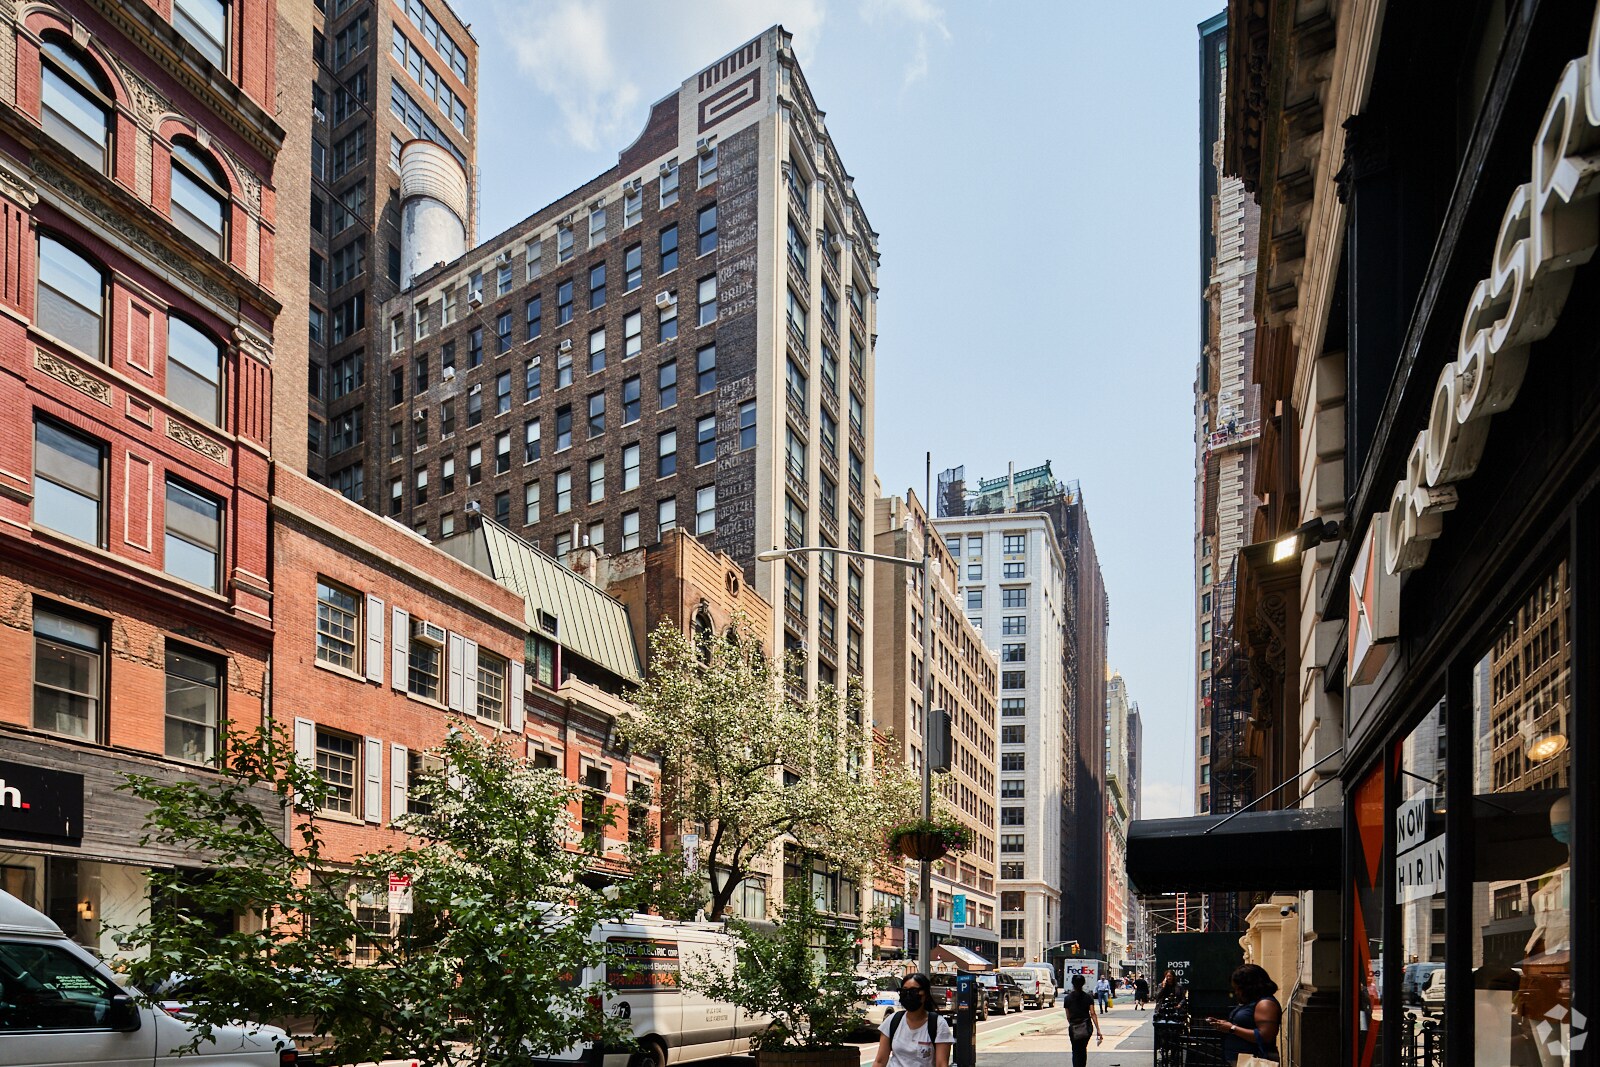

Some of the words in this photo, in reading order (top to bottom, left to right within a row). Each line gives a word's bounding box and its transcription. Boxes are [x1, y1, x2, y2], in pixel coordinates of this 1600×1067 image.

[721, 278, 753, 302] BRICK
[1385, 0, 1600, 577] CROSSR
[1399, 801, 1424, 844] NOW
[1067, 966, 1094, 975] FedEx
[1167, 961, 1189, 969] POST
[961, 982, 968, 992] P
